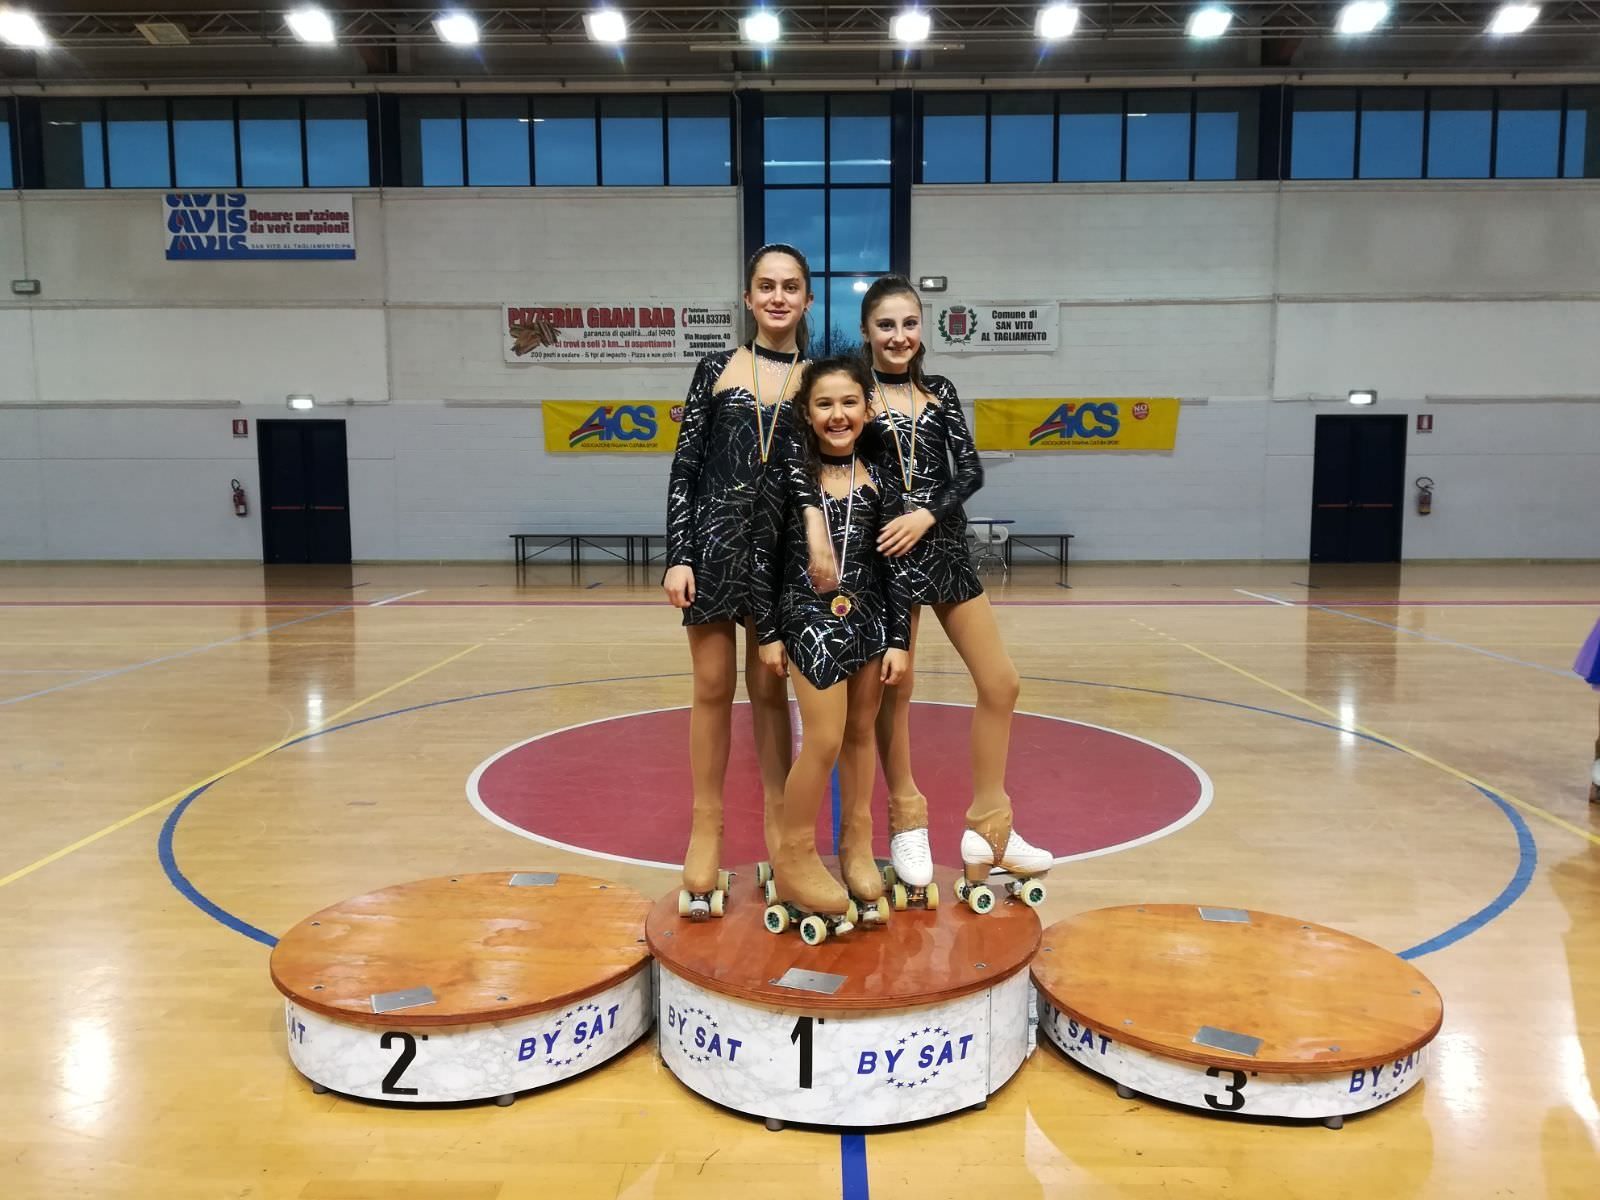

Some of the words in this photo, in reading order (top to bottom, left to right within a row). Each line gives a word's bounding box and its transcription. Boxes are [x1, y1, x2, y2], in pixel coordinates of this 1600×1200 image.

[168, 209, 248, 233] AVIS
[249, 209, 293, 221] Donare:
[295, 209, 349, 221] un'azione
[250, 222, 264, 233] da
[267, 222, 291, 233] veri
[294, 222, 349, 235] campioni!
[587, 308, 635, 328] GRAN
[639, 308, 675, 328] BAR
[688, 314, 705, 324] 0434
[992, 310, 1026, 319] Comune
[1029, 309, 1037, 319] di
[996, 321, 1011, 330] SAN
[1015, 321, 1033, 330] VITO
[583, 330, 611, 338] garanzia
[612, 329, 619, 337] di
[658, 329, 675, 337] 1990
[981, 332, 991, 341] AL
[994, 332, 1047, 341] TAGLIAMENTO
[563, 340, 580, 348] trovi
[587, 340, 600, 348] soli
[602, 340, 607, 348] 3
[671, 407, 684, 415] NO
[1134, 404, 1147, 412] NO
[518, 1030, 561, 1062] BY
[573, 1004, 619, 1044] SAT
[668, 1005, 687, 1036] BY
[694, 1027, 743, 1062] SAT
[1068, 1019, 1112, 1055] SAT
[857, 1048, 905, 1075] BY
[917, 1034, 974, 1069] SAT
[1349, 1064, 1385, 1093] BY
